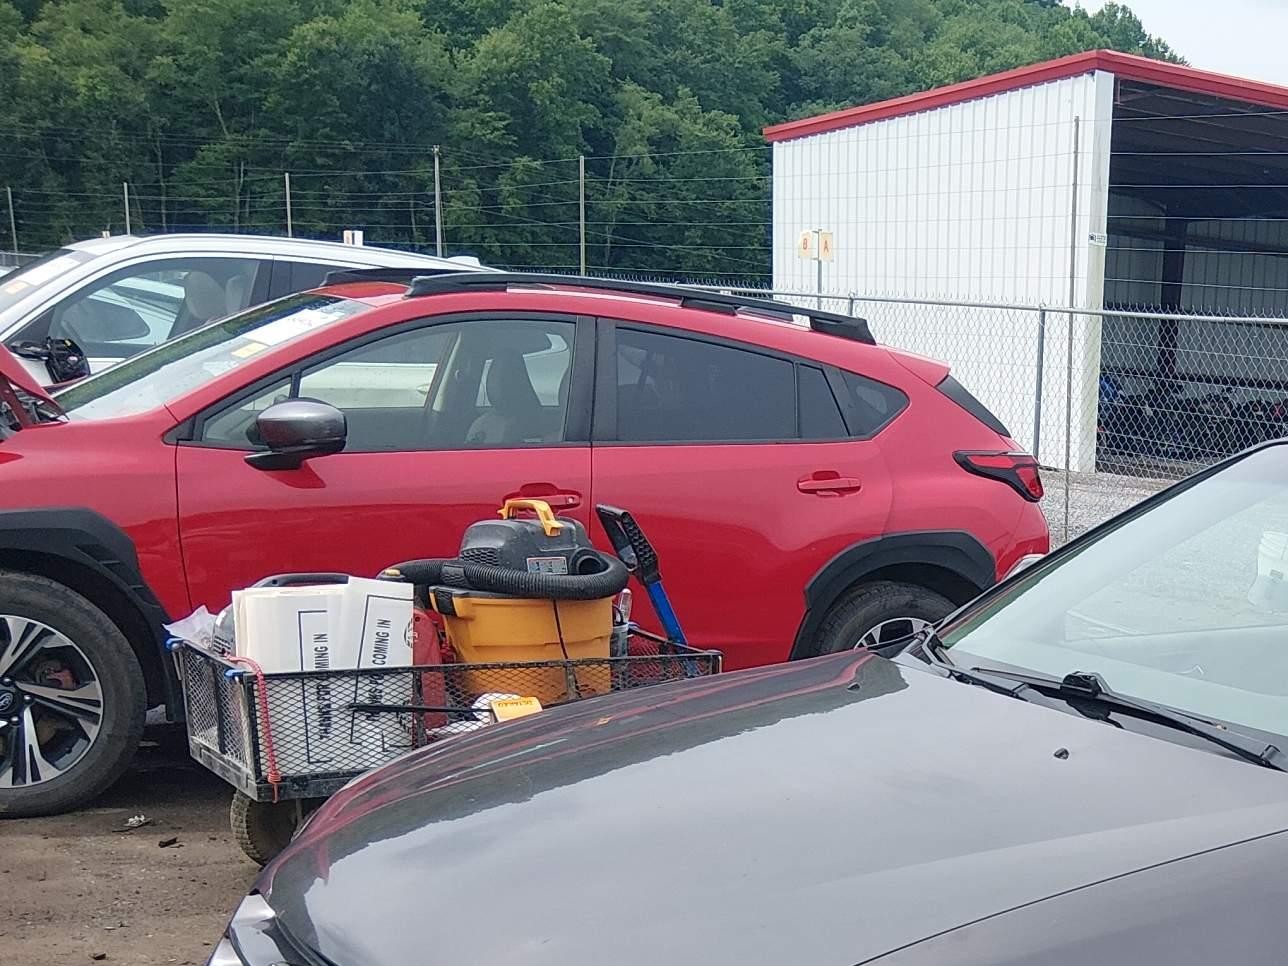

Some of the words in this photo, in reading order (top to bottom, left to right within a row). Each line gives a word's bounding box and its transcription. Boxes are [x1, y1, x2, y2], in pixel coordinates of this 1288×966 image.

[823, 240, 829, 253] A
[376, 619, 391, 629] IN
[313, 633, 328, 643] IN
[372, 631, 390, 665] COMING
